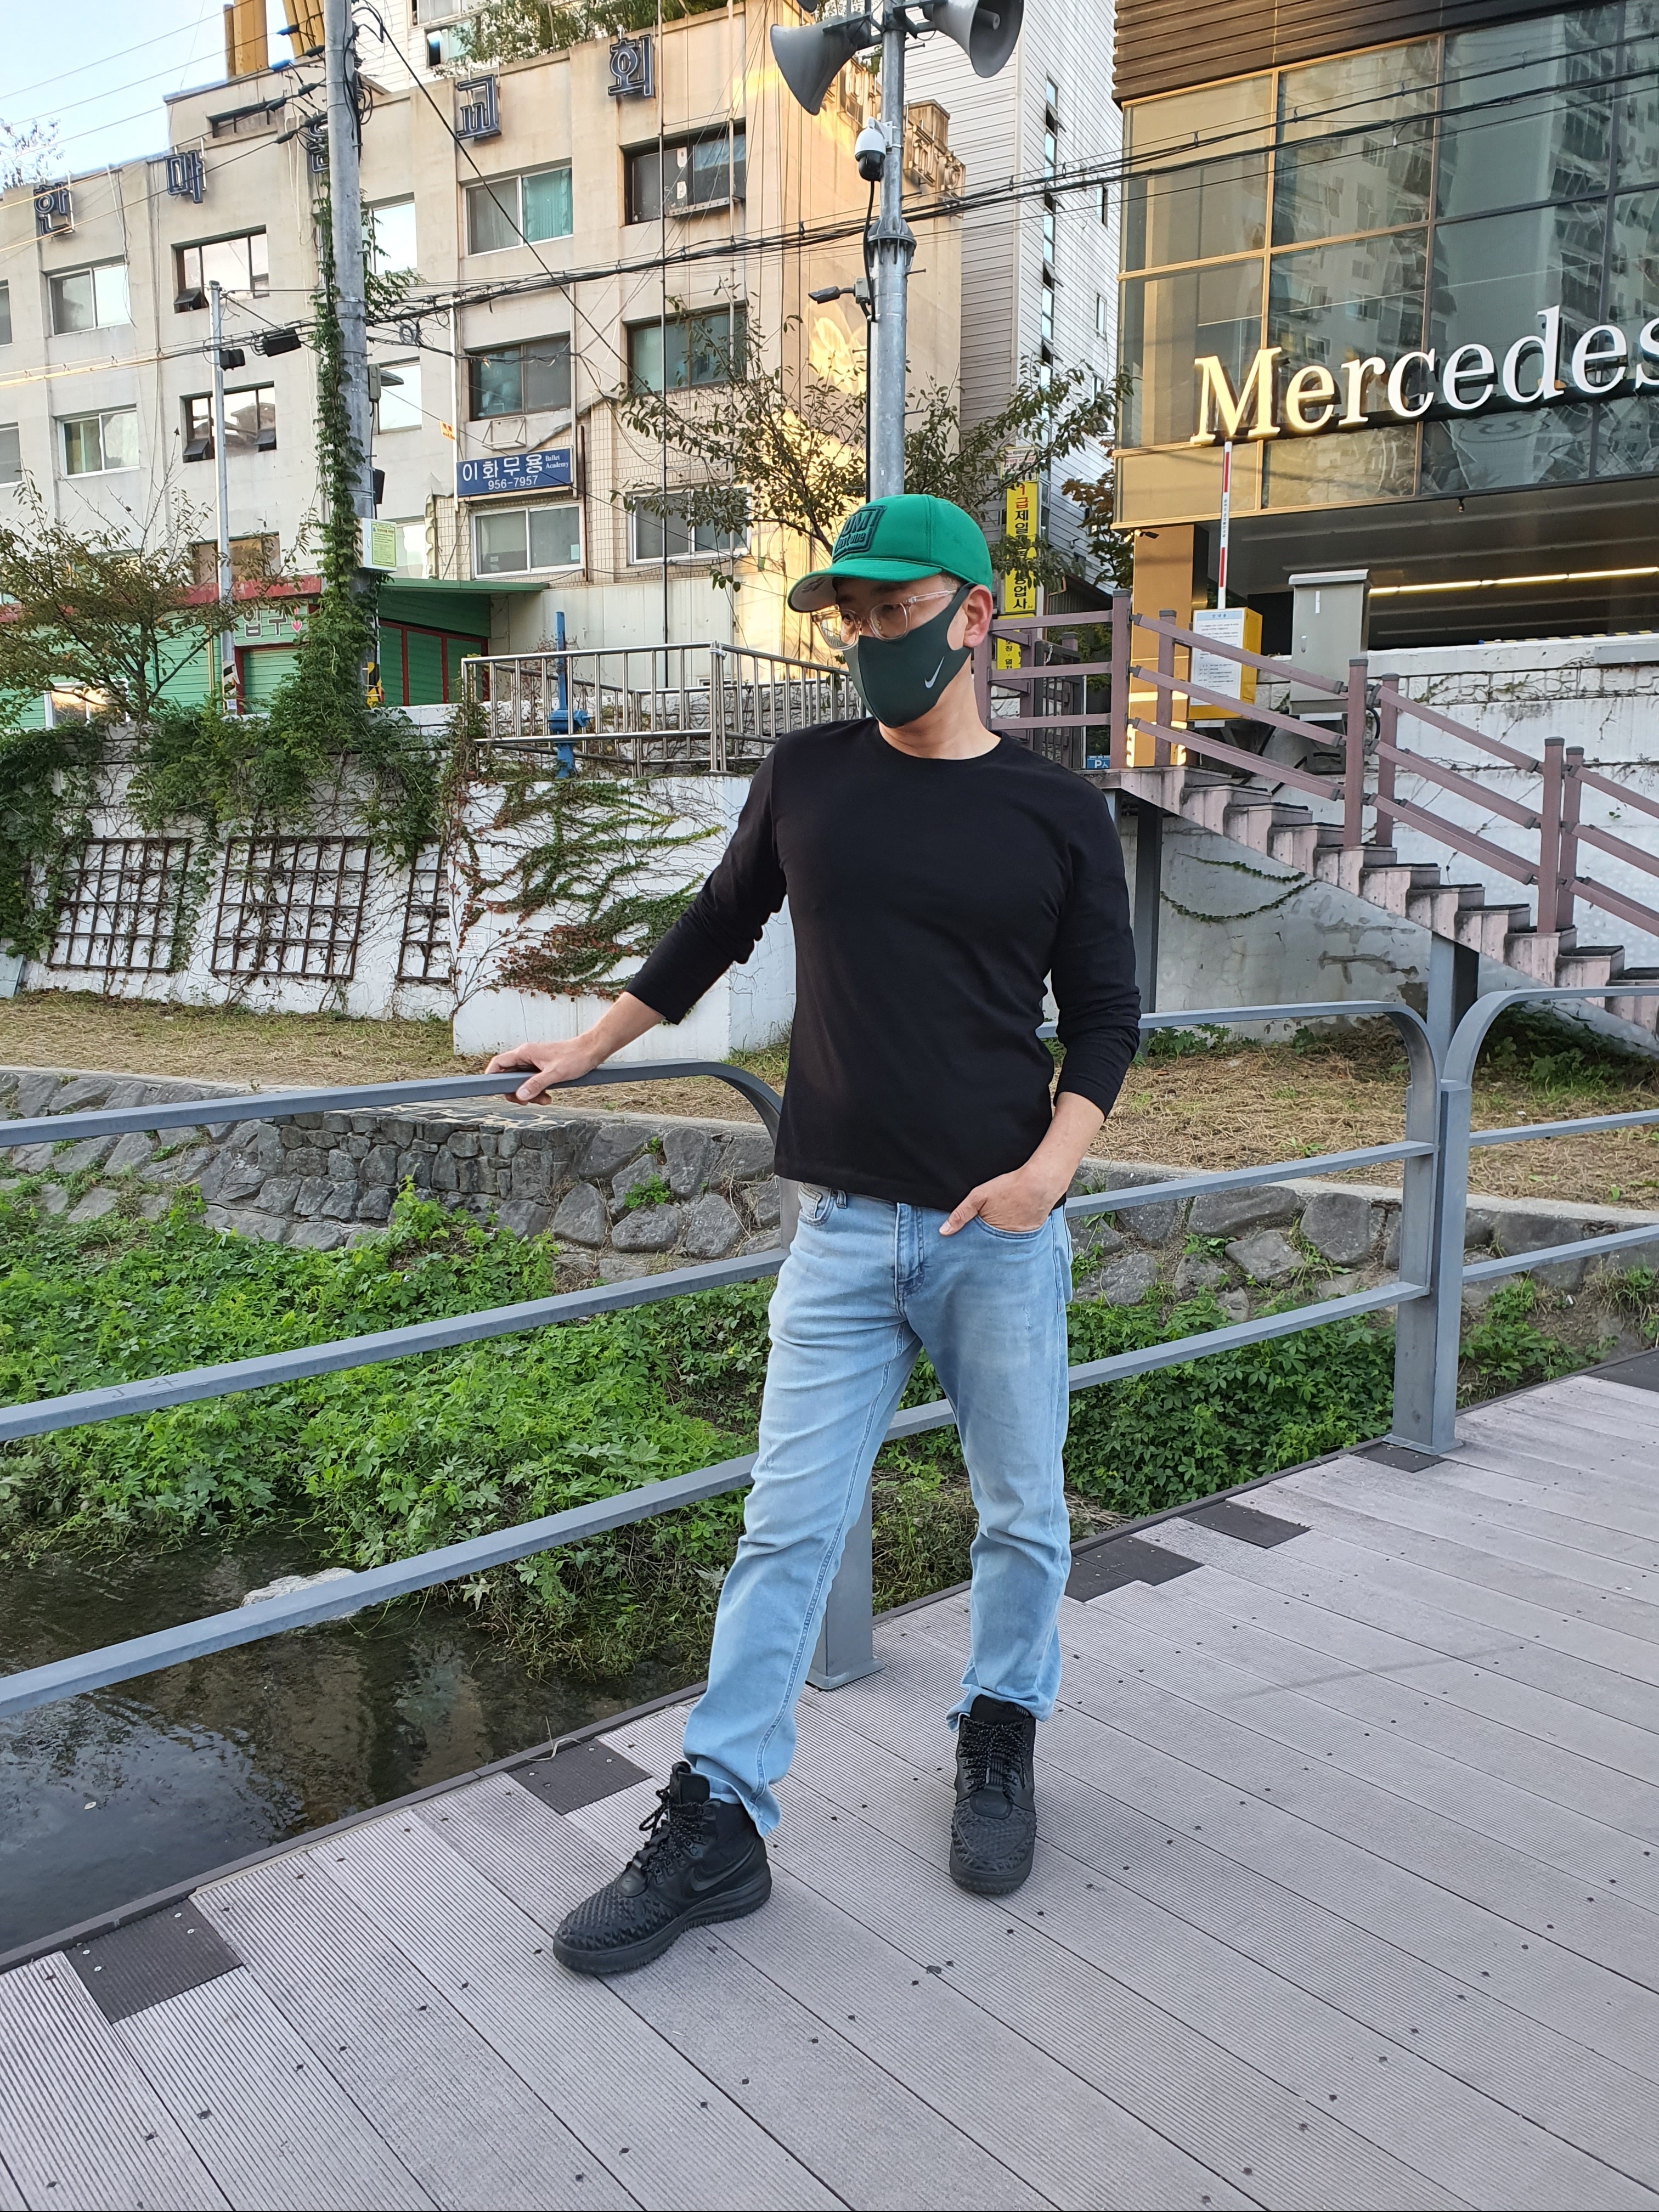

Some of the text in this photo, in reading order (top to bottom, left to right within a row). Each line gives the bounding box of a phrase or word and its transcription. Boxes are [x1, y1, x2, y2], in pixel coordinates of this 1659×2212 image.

[456, 74, 501, 140] 교
[608, 34, 653, 98] 회
[462, 454, 543, 482] 이화무용
[545, 461, 569, 470] Academy
[488, 475, 538, 490] 956-7957
[1094, 760, 1102, 768] P
